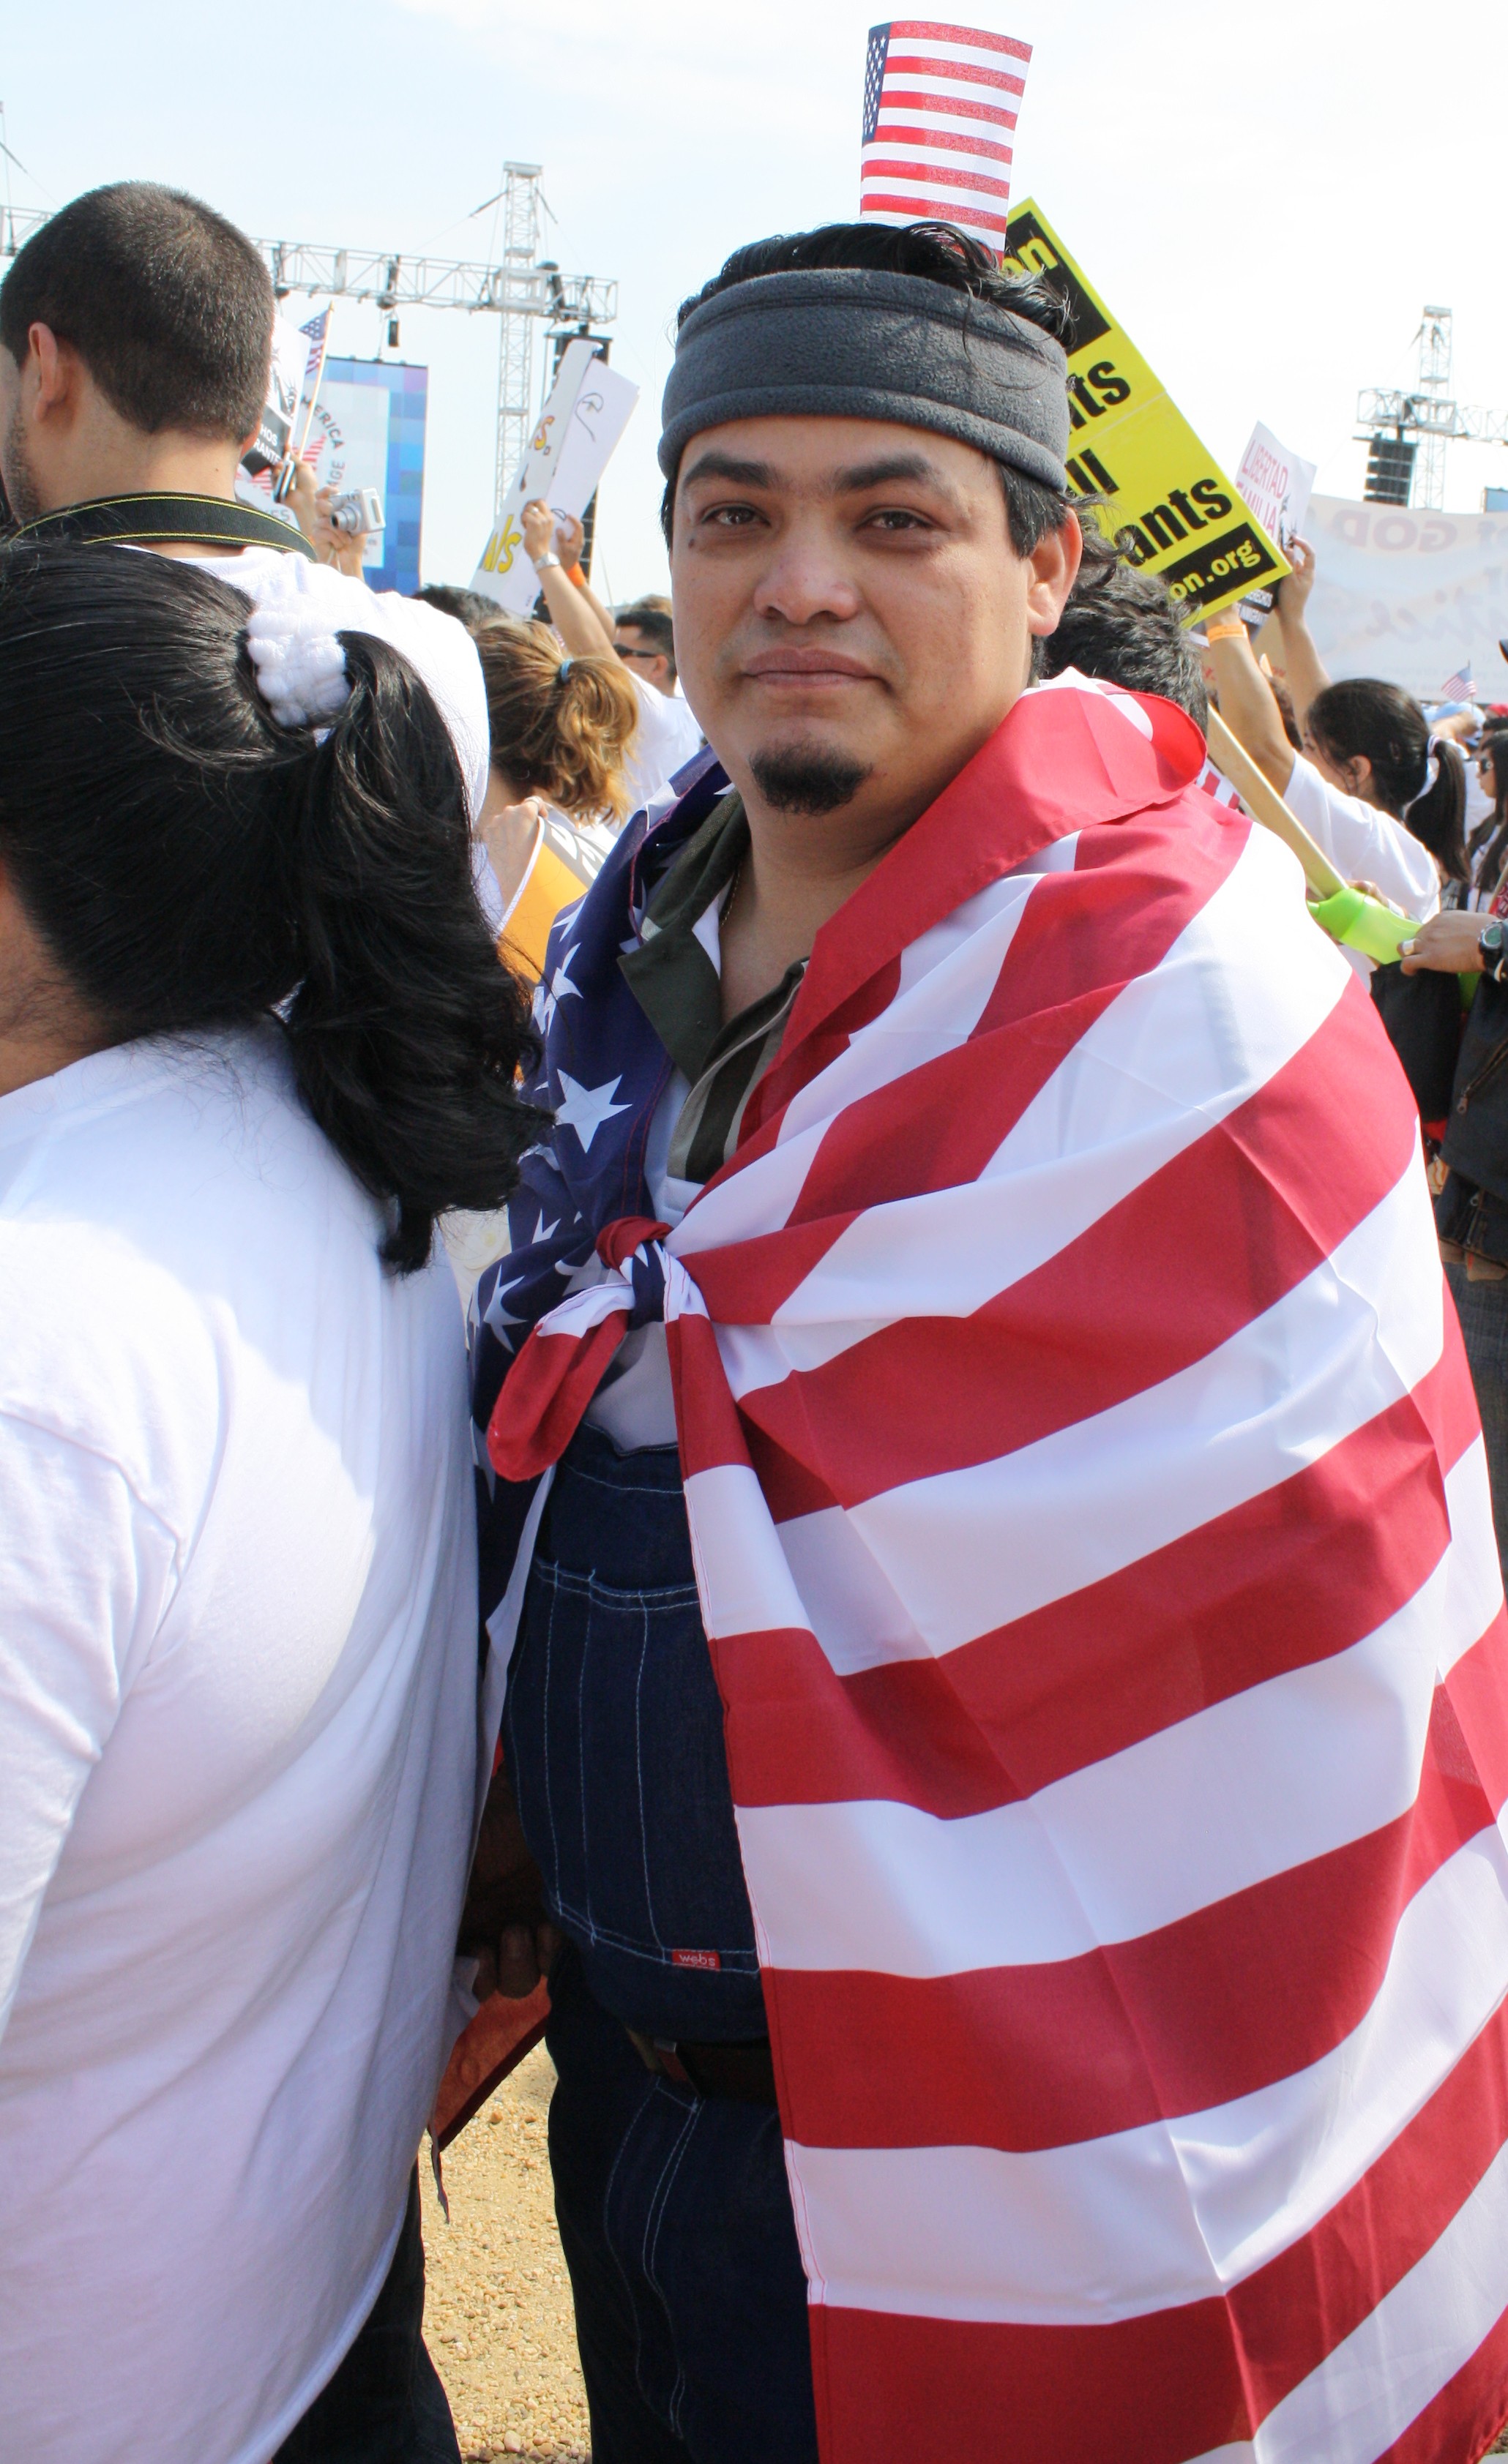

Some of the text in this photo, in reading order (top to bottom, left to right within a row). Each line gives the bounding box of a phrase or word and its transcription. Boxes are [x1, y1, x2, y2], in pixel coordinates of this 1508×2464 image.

[1069, 361, 1131, 430] ts
[1064, 448, 1120, 496] ll
[1242, 439, 1288, 506] LIBERTAD
[1113, 479, 1233, 568] ants
[1170, 539, 1261, 602] on.org
[679, 1953, 716, 1967] webs
